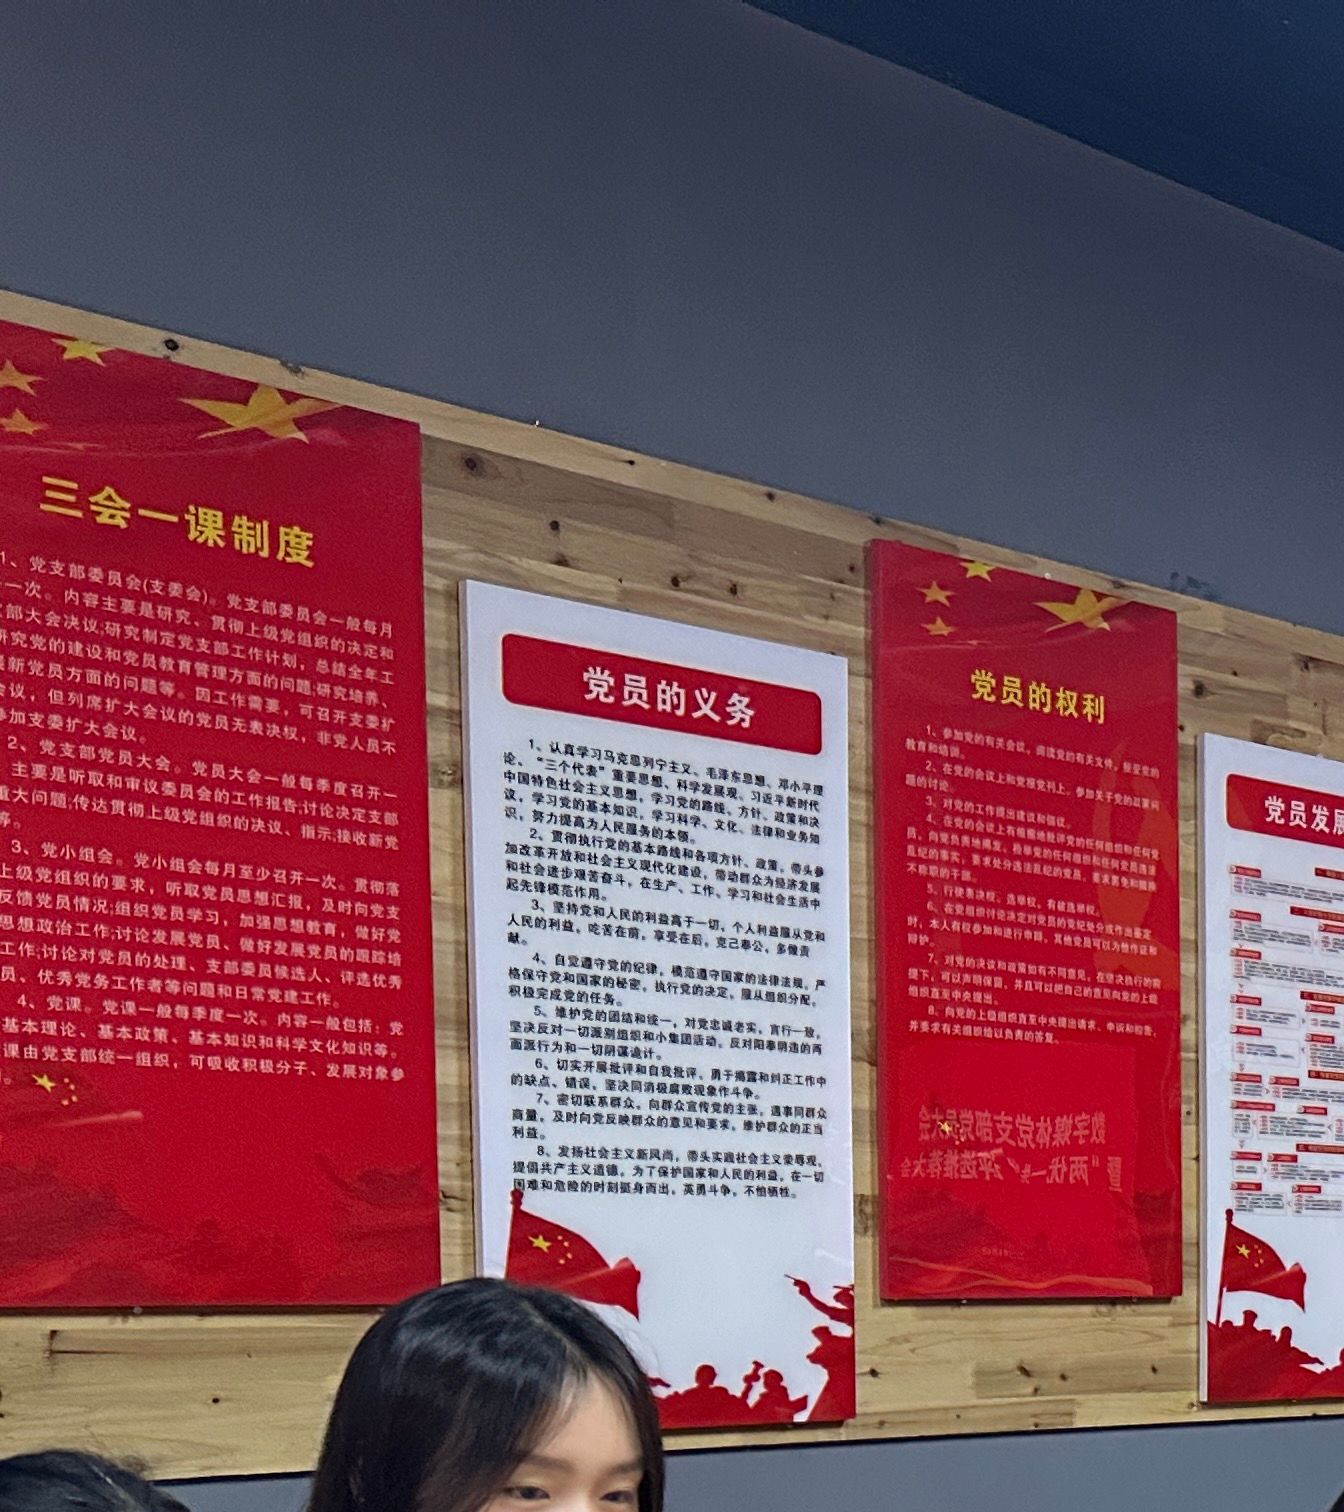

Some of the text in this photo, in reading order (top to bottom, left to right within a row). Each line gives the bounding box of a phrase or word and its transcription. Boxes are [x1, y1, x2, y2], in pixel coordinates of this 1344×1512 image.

[40, 472, 314, 567] 三会一课制度
[0, 575, 393, 662] 一次。内容主要是研究、贯彻上级党组织的决定和
[0, 601, 394, 686] 部大会决议;研究制定党支部工作计划，总结全年工
[0, 654, 395, 733] 新党员方面的问题等。因工作需要，可召开支委扩
[0, 680, 396, 757] 议，但列席扩大会议的党员无表决权，非党人员不
[0, 706, 146, 743] 加支委扩大会议。
[582, 664, 755, 730] 党员的义务
[970, 668, 1104, 725] 党员的权利
